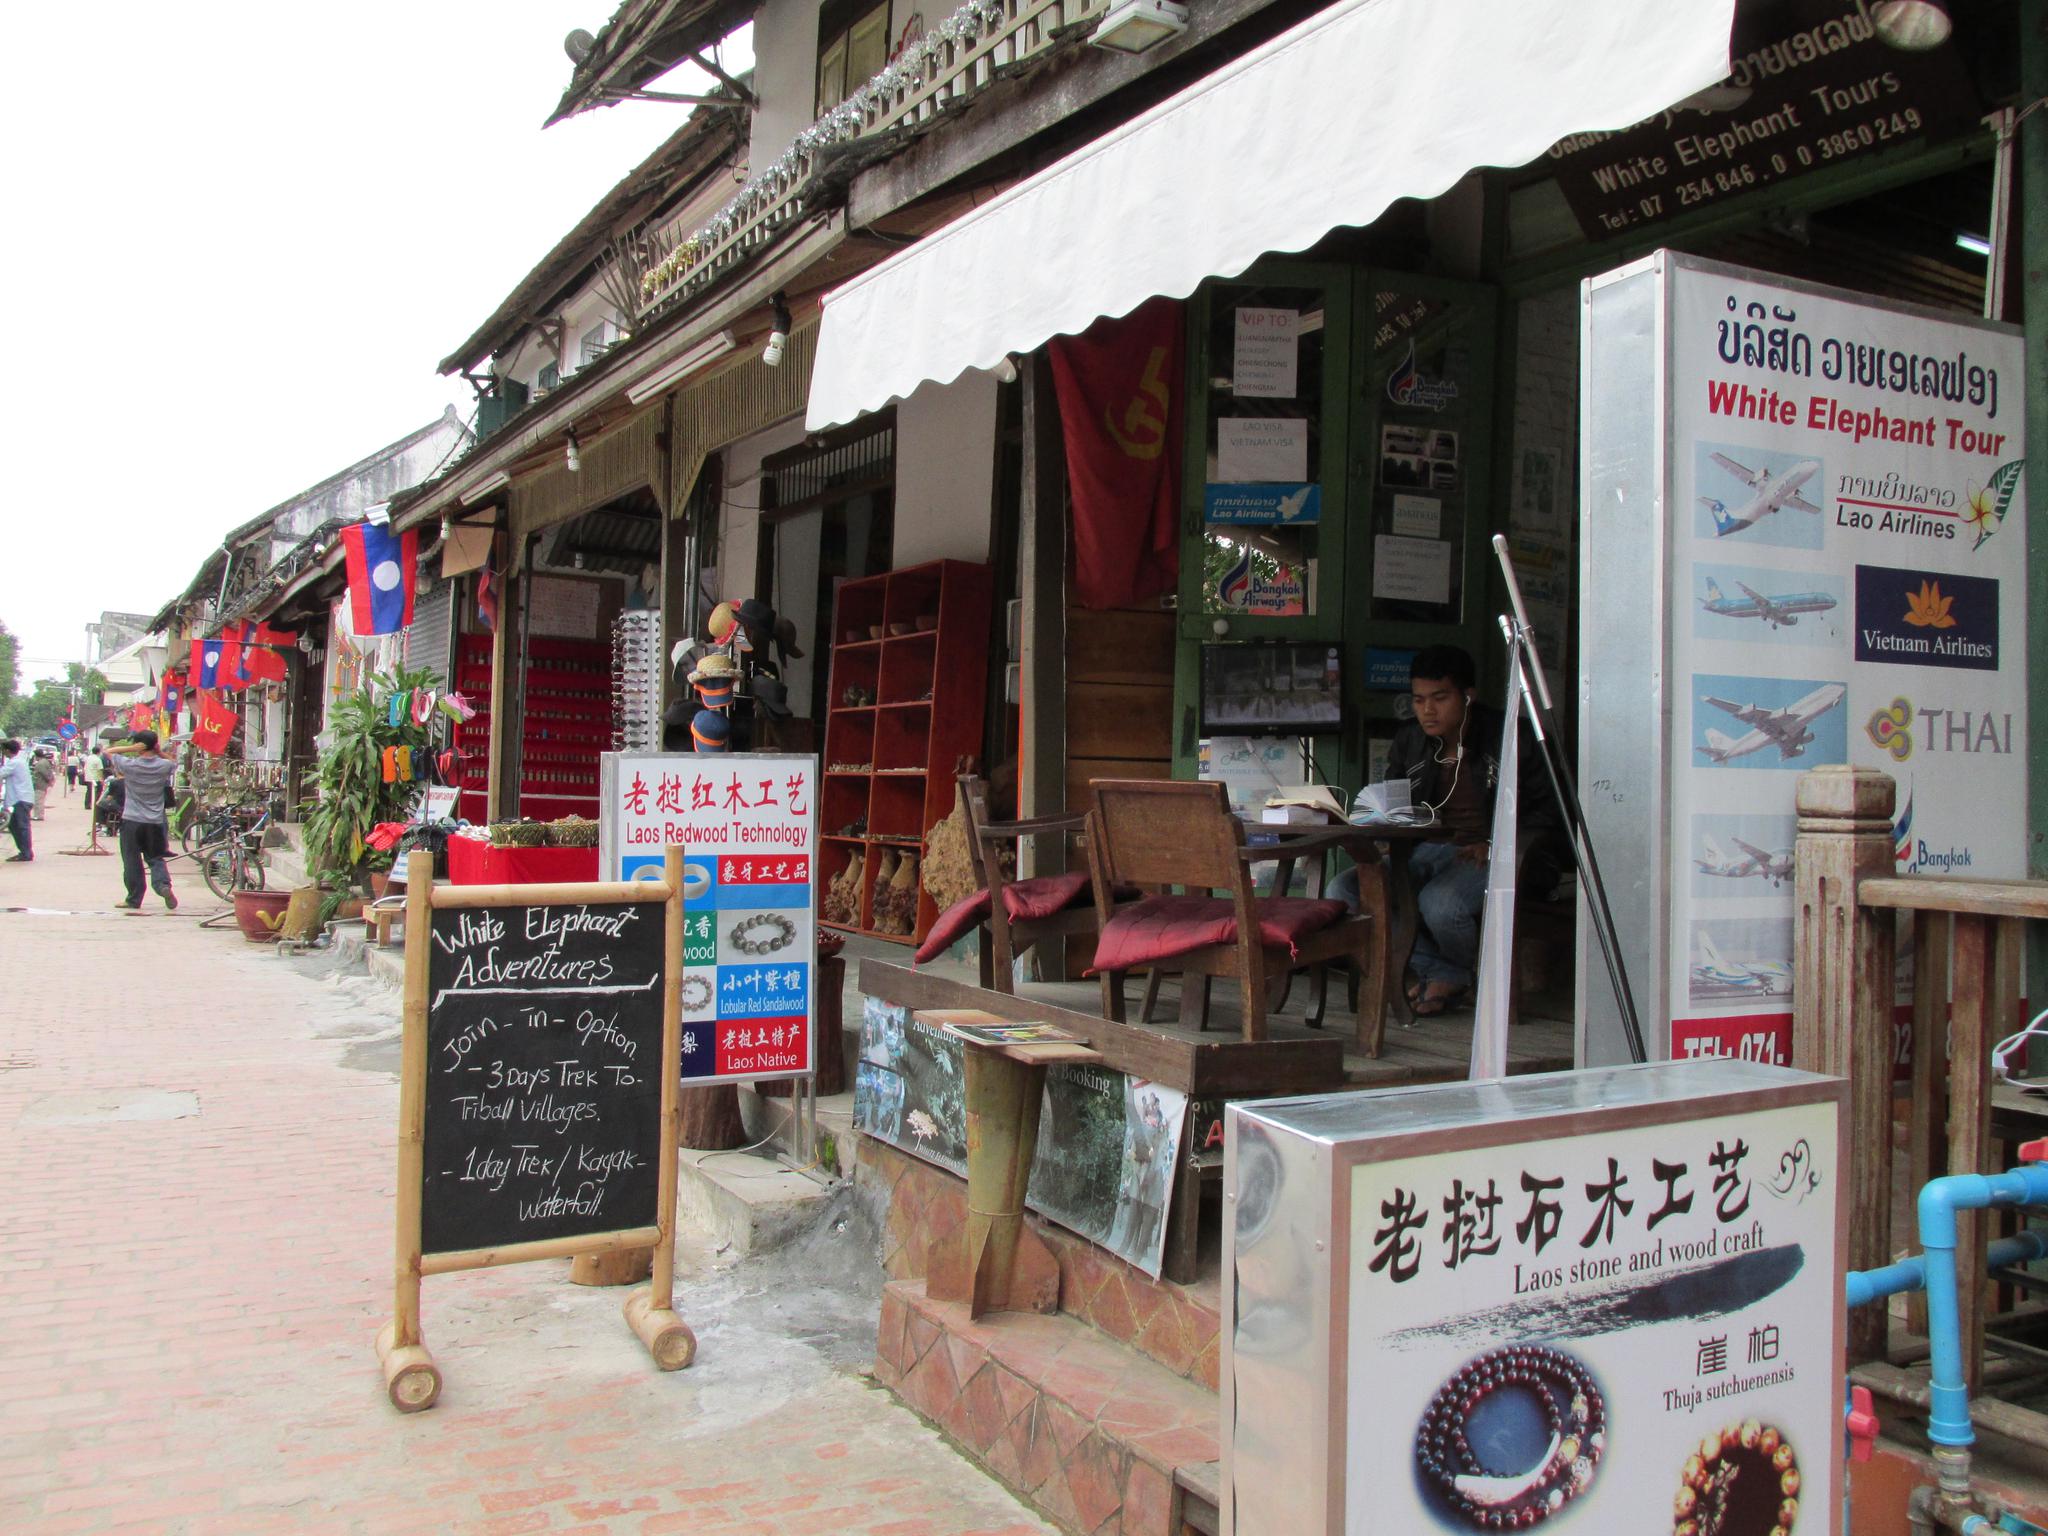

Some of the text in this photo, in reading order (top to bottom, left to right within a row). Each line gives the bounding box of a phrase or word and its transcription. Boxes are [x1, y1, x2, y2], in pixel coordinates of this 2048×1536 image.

[1592, 155, 1669, 195] White
[1674, 102, 1801, 167] Elephant
[1810, 71, 1900, 116] Tours
[1598, 207, 1638, 231] Tel:
[1242, 312, 1265, 327] VIP
[1408, 389, 1446, 410] Airways
[1415, 374, 1457, 399] Bangkok
[1708, 379, 2006, 457] White Elephant Tour
[1212, 509, 1276, 520] Lao Airlines
[1836, 504, 1955, 540] Lao Airlines
[1241, 590, 1286, 611] Airways
[1253, 577, 1300, 600] Bangkok
[1863, 629, 1992, 658] Vietnam Airlines
[1917, 705, 2013, 755] THAI
[624, 770, 807, 816] 老挝红木工艺
[627, 820, 807, 848] Laos Redwood Technology
[1918, 839, 1972, 873] Bangkok
[722, 860, 809, 882] 象牙工艺品
[432, 905, 639, 953] White Elephant
[683, 942, 715, 960] wood
[453, 944, 613, 988] Adventures
[723, 969, 801, 993] 小叶紫檀
[721, 995, 804, 1015] Lobular Red Sandalwood
[682, 1031, 699, 1055] 梨
[722, 1024, 801, 1050] 老挝土特产
[728, 1051, 798, 1070] Laos Native
[1062, 1063, 1111, 1099] Booking
[1368, 1137, 1750, 1283] 老挝石木工艺
[1513, 1221, 1765, 1295] Laos stone and wood craft
[1696, 1324, 1779, 1377] 崖柏
[1663, 1362, 1795, 1413] Thuja sutchuenensis
